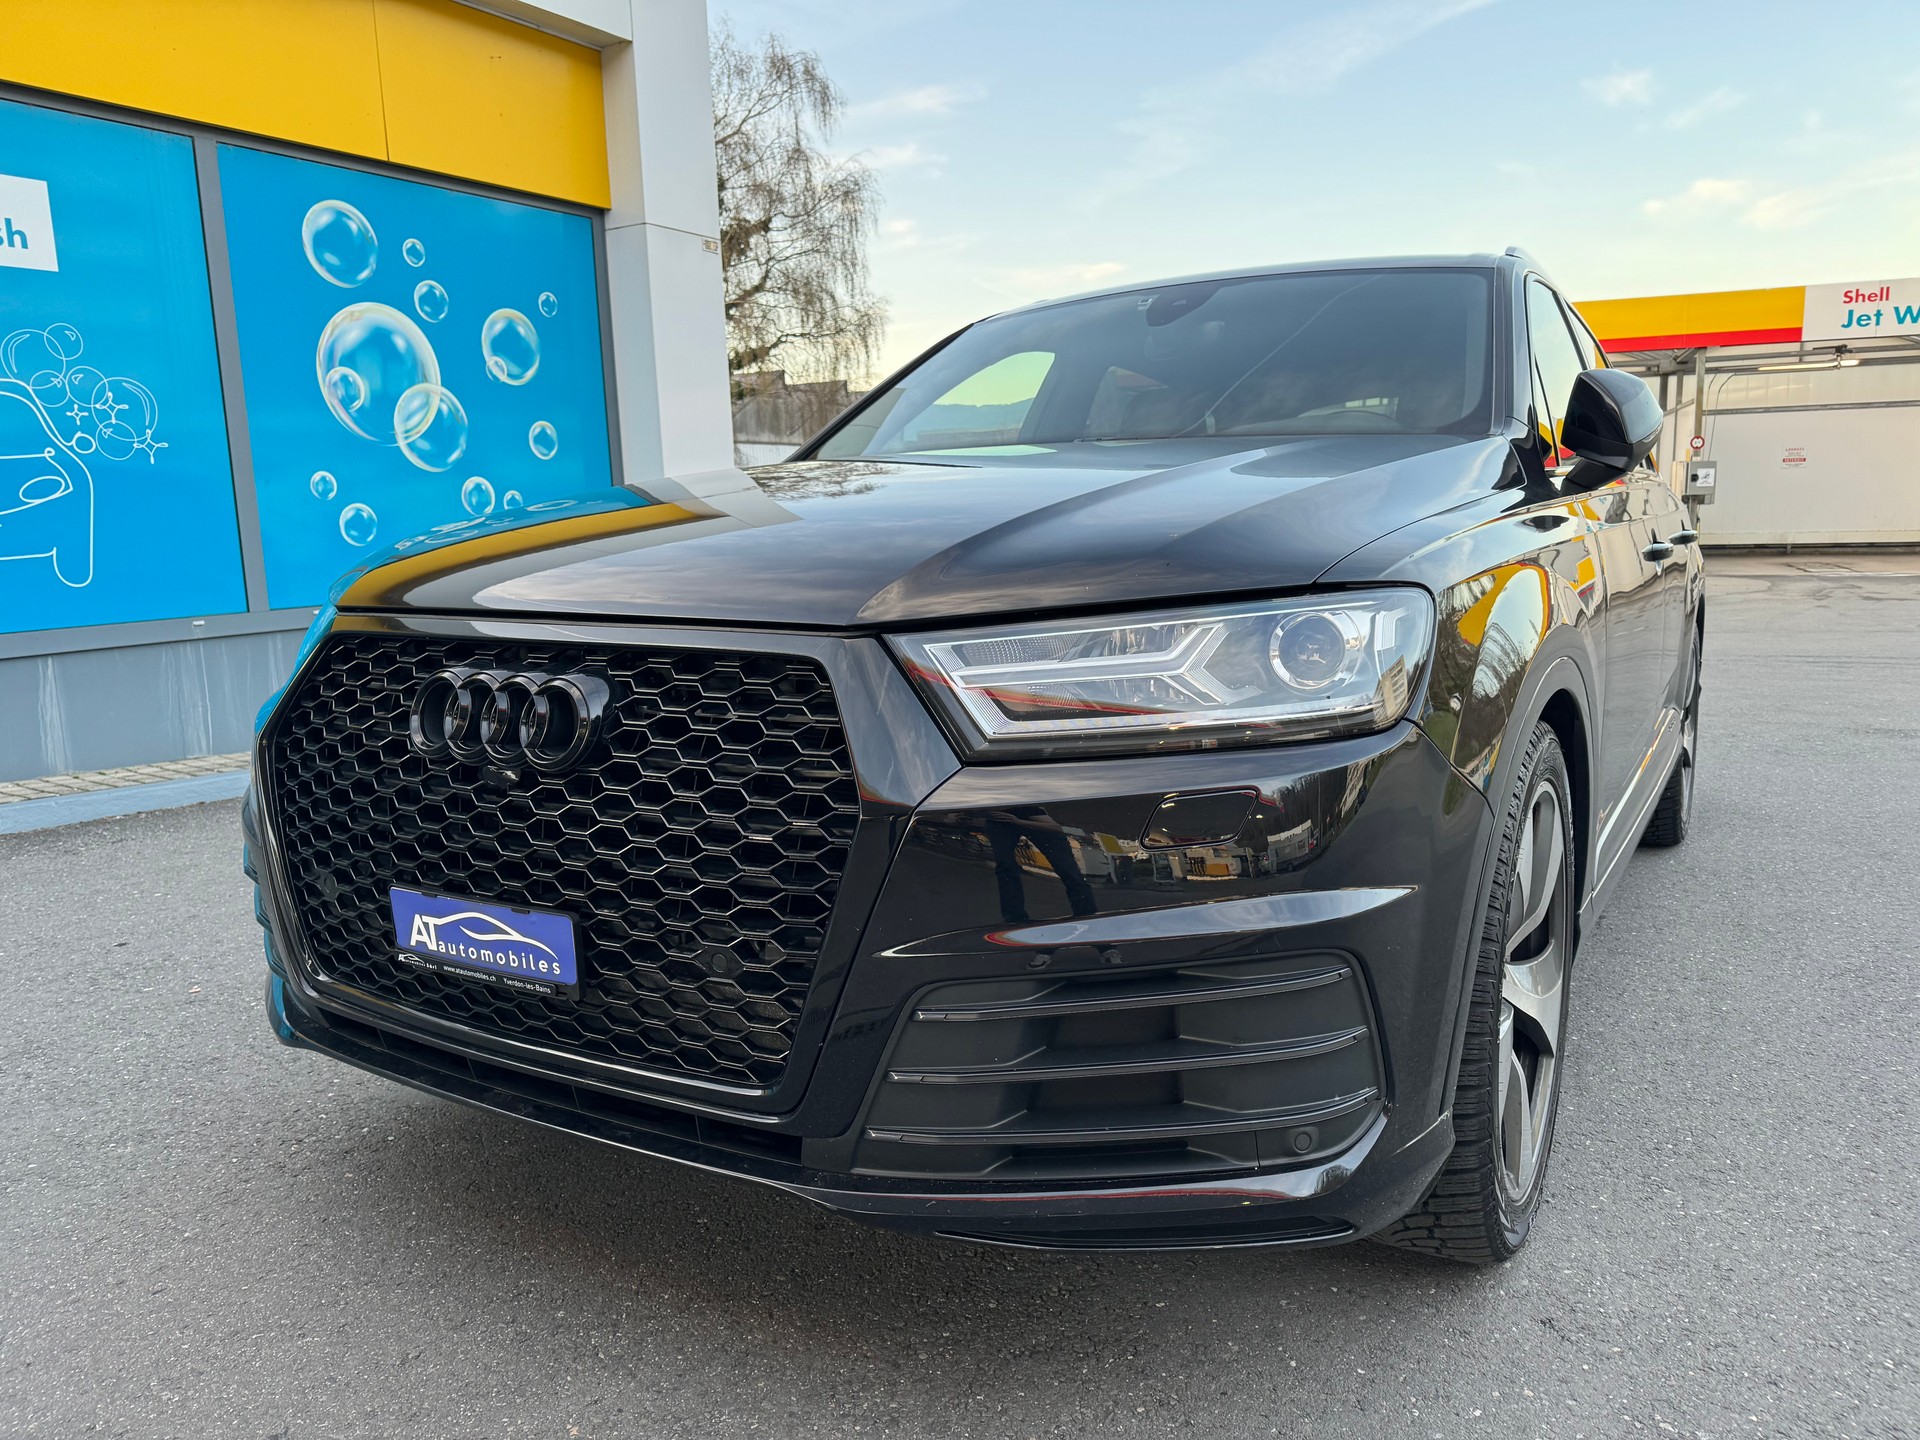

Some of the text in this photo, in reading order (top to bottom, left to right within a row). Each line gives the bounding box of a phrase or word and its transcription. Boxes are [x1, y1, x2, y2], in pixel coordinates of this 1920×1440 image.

[1842, 286, 1891, 304] Shell
[1841, 305, 1920, 329] Jet W
[410, 914, 561, 975] AT automobiles
[443, 965, 497, 982] www.atautomobiles.ch
[503, 977, 552, 994] Yverdon-les-Bains
